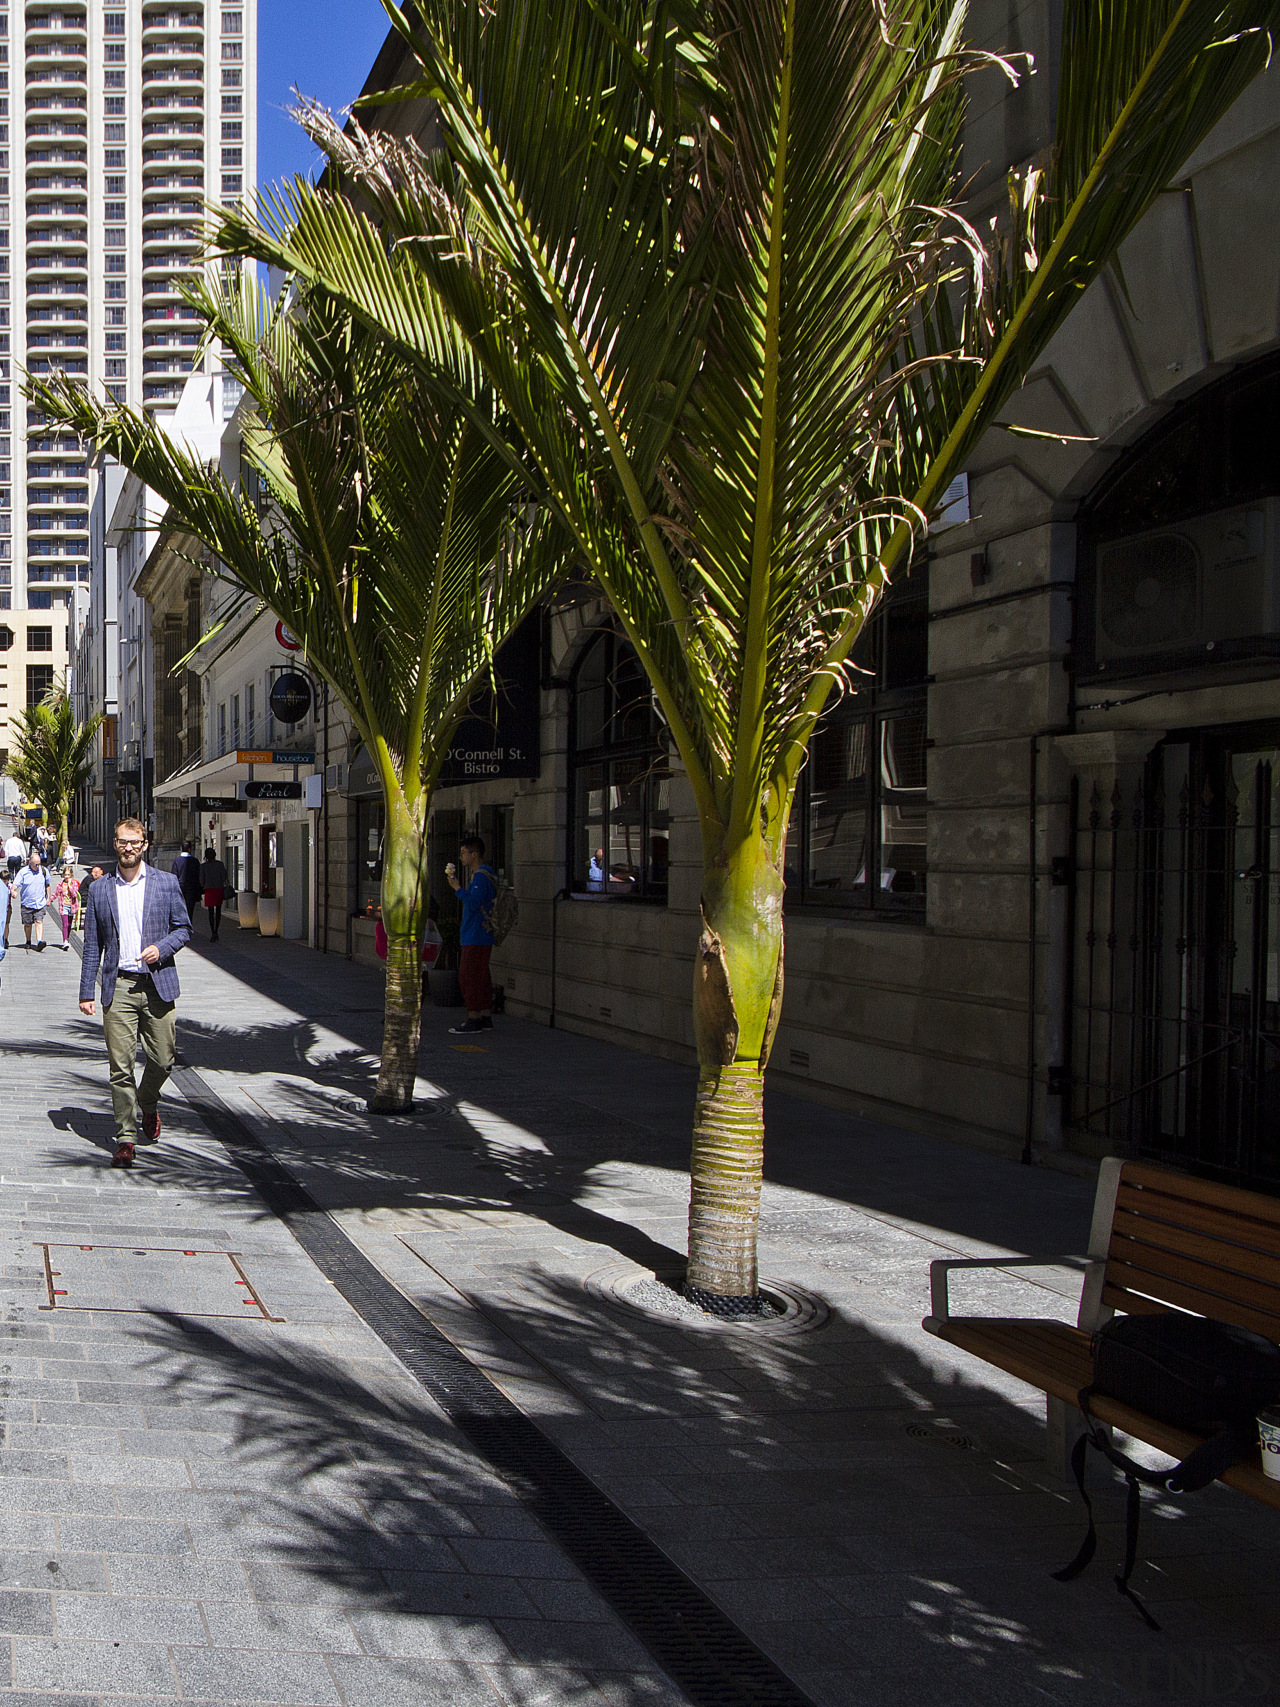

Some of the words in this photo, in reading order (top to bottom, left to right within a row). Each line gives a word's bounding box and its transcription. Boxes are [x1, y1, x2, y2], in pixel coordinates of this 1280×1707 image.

[242, 753, 267, 761] kitchen
[276, 754, 310, 762] housebar
[509, 748, 526, 760] St.
[464, 762, 500, 774] Bistro
[258, 783, 290, 797] Pearl
